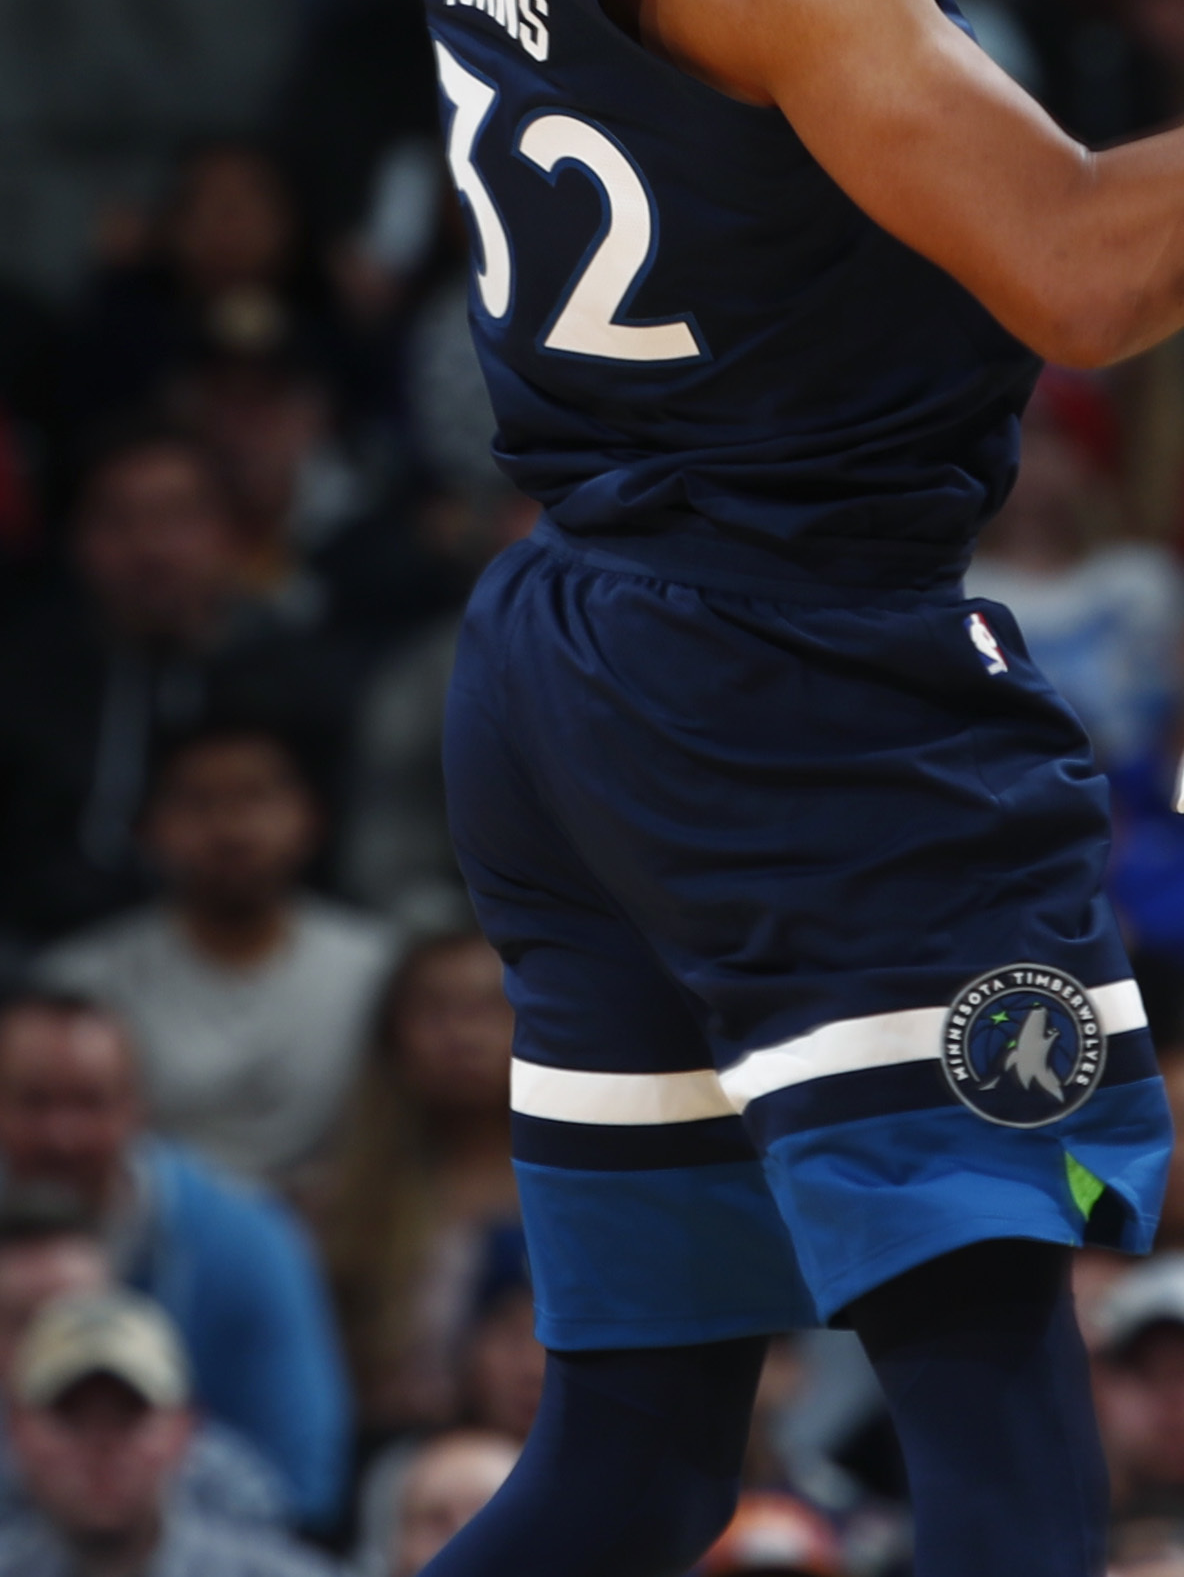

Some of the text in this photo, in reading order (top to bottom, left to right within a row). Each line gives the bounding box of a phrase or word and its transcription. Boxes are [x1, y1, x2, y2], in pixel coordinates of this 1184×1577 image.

[434, 37, 703, 362] 32
[946, 972, 1099, 1087] MINNESOTA TIMBERWOLVES
